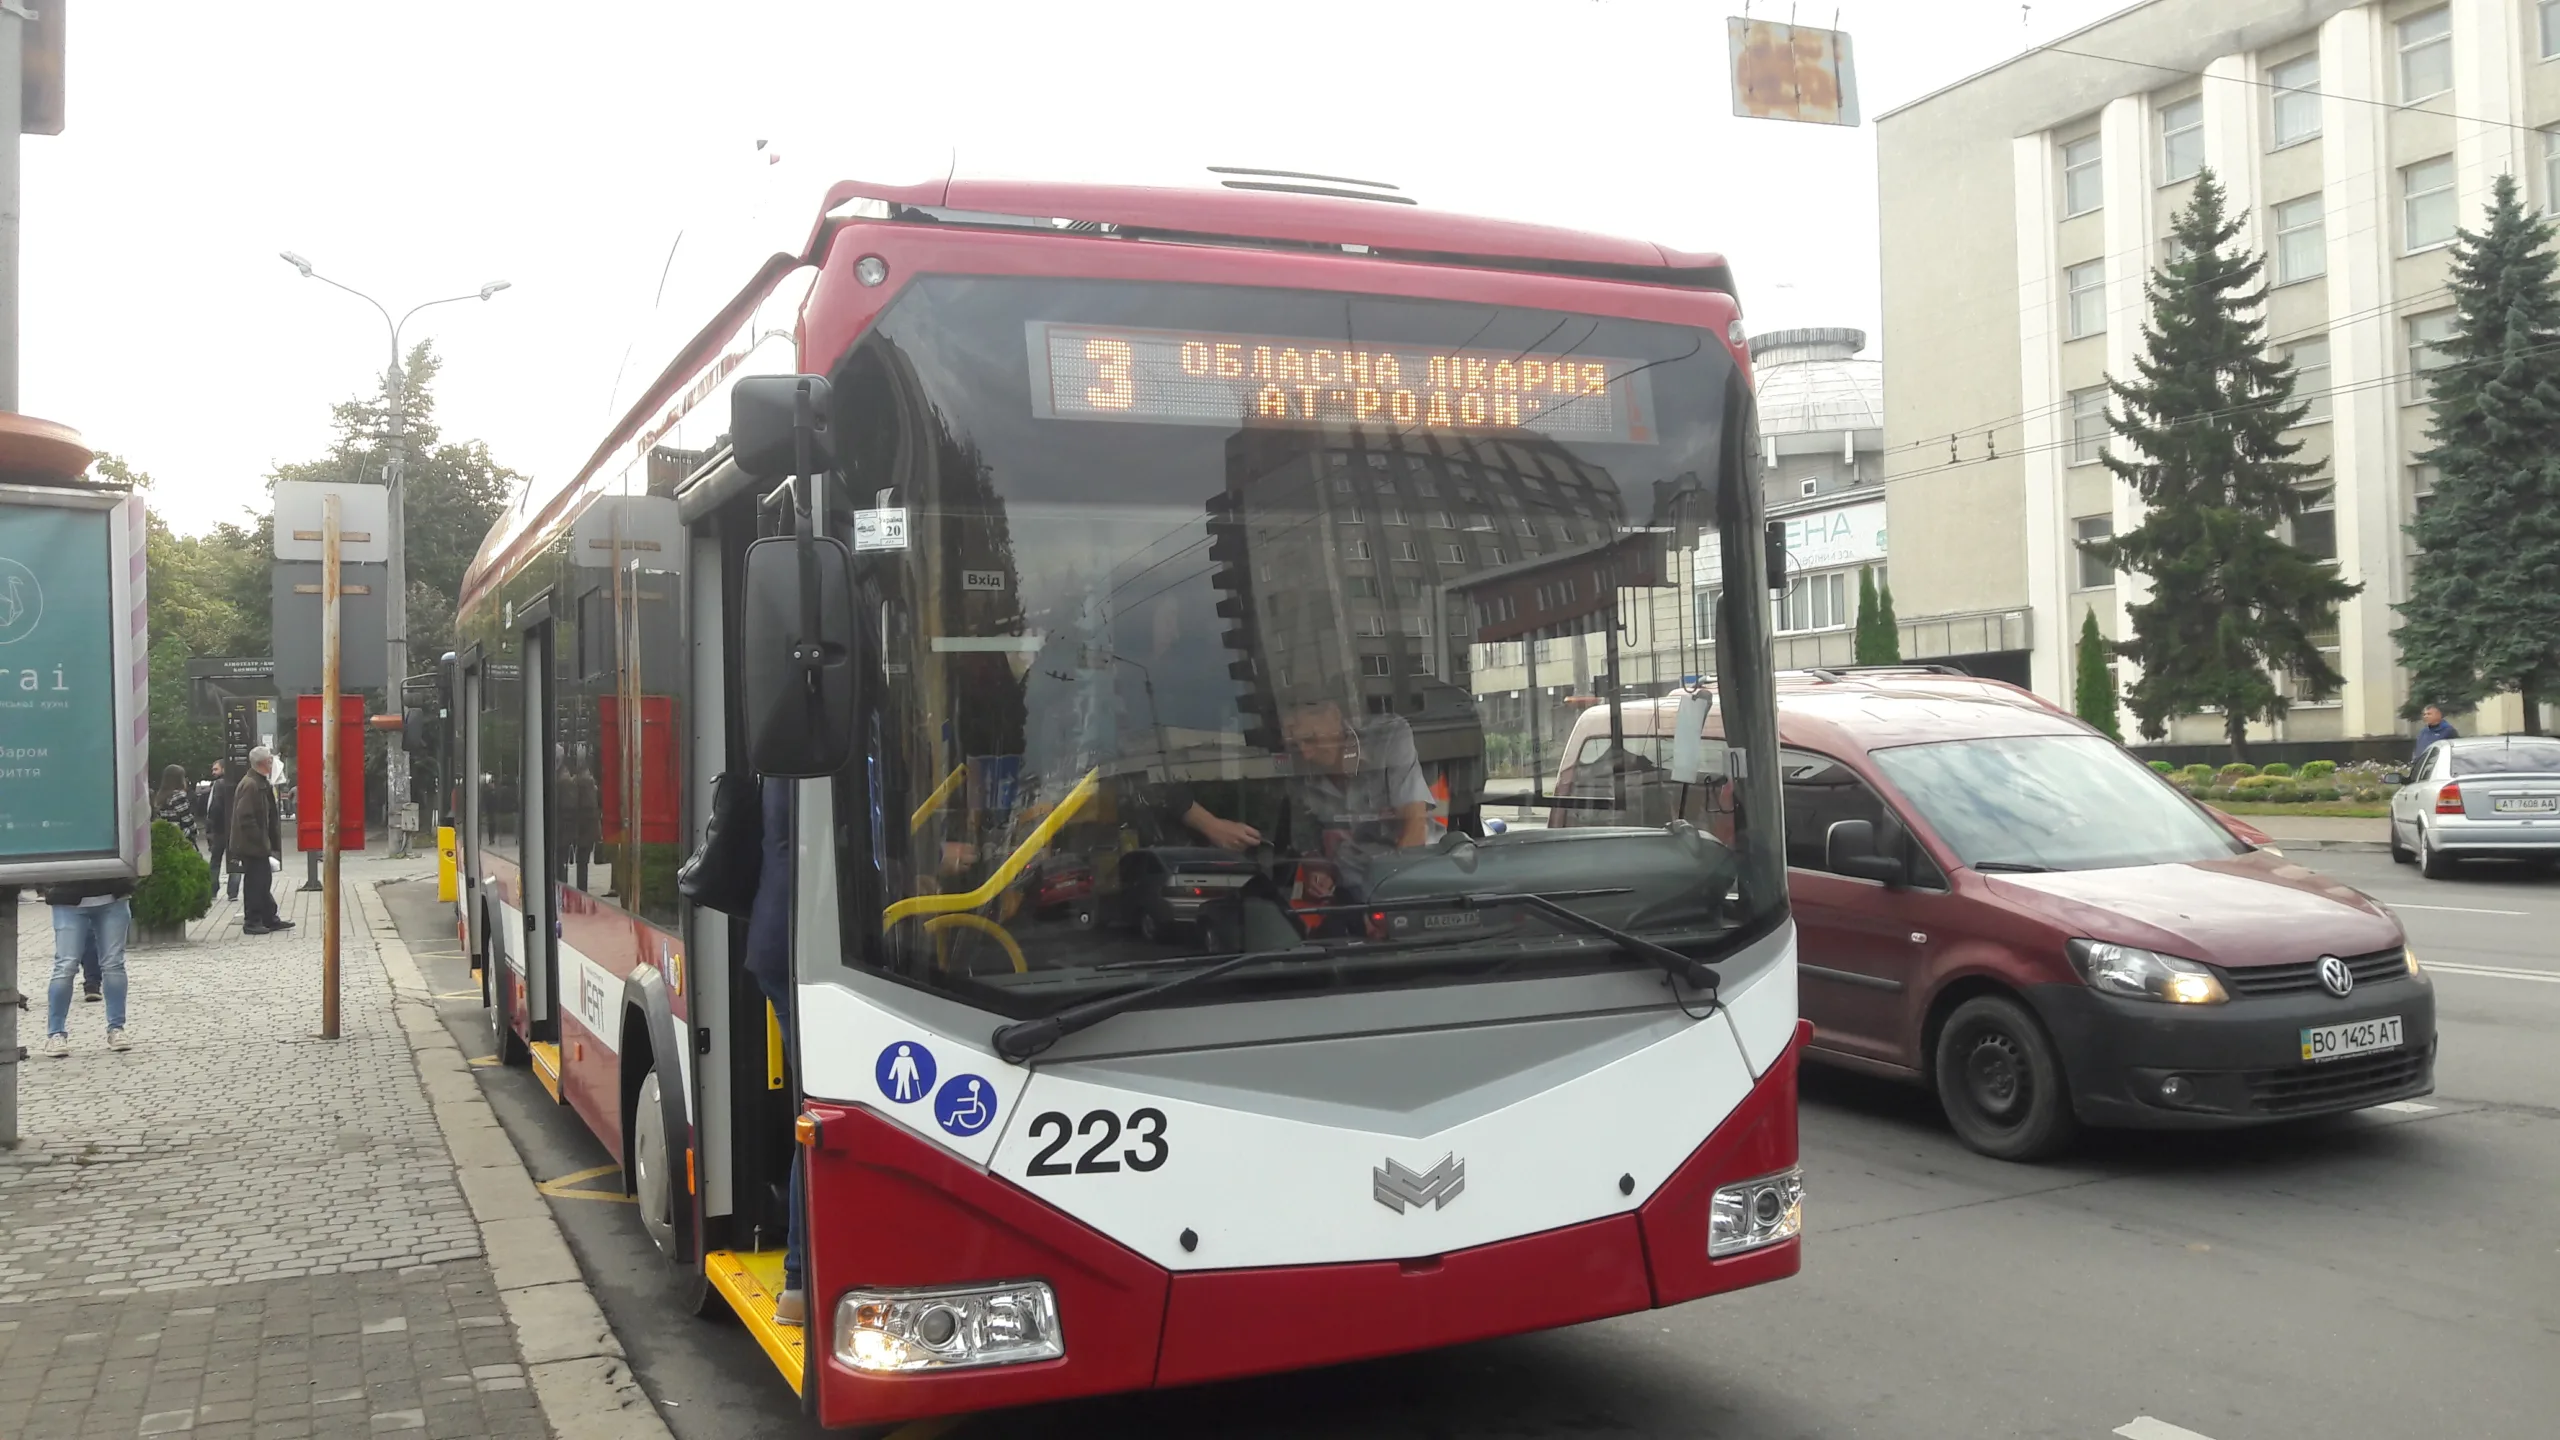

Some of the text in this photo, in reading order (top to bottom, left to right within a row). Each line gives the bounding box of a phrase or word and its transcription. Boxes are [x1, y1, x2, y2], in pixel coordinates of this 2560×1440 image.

[1085, 339, 1133, 409] 3
[1181, 341, 1605, 395] ОБЛАСНА ЛІКАРНЯ
[886, 525, 901, 537] 20
[968, 574, 1001, 587] Вхід
[2502, 800, 2554, 808] AT 7608 AA
[2312, 1030, 2336, 1053] BO
[2341, 1024, 2376, 1049] 1425
[2379, 1020, 2399, 1043] AT
[1025, 1107, 1169, 1177] 223
